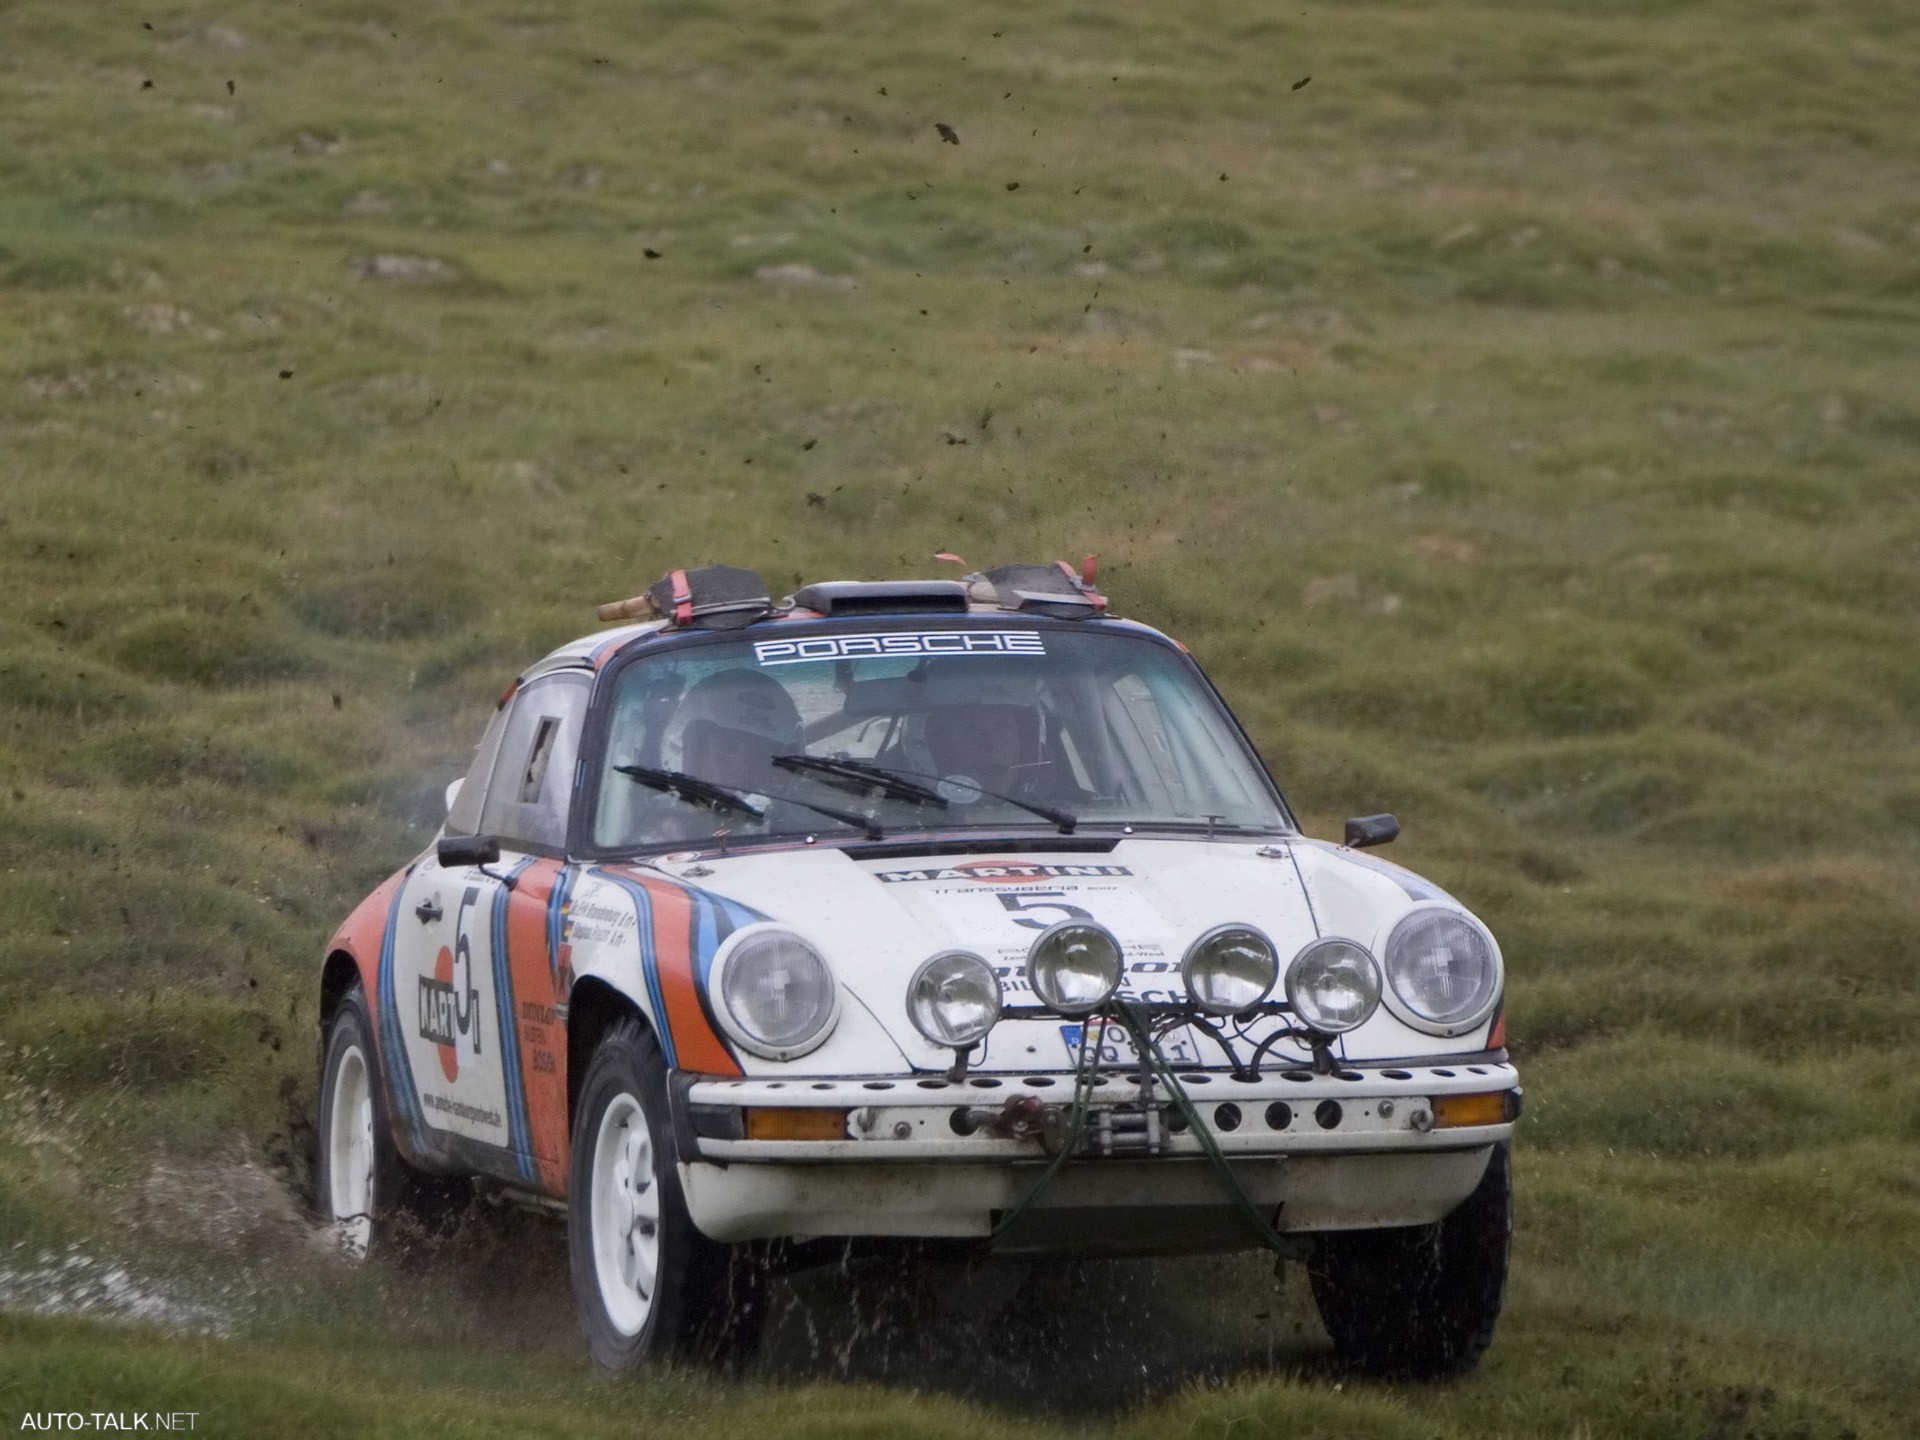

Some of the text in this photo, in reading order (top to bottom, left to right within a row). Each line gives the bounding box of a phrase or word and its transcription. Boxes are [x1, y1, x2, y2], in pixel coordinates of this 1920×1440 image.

[756, 633, 1046, 663] PORSCHE
[885, 865, 1125, 883] MARTINI
[995, 891, 1095, 930] 5
[454, 886, 480, 1036] 5
